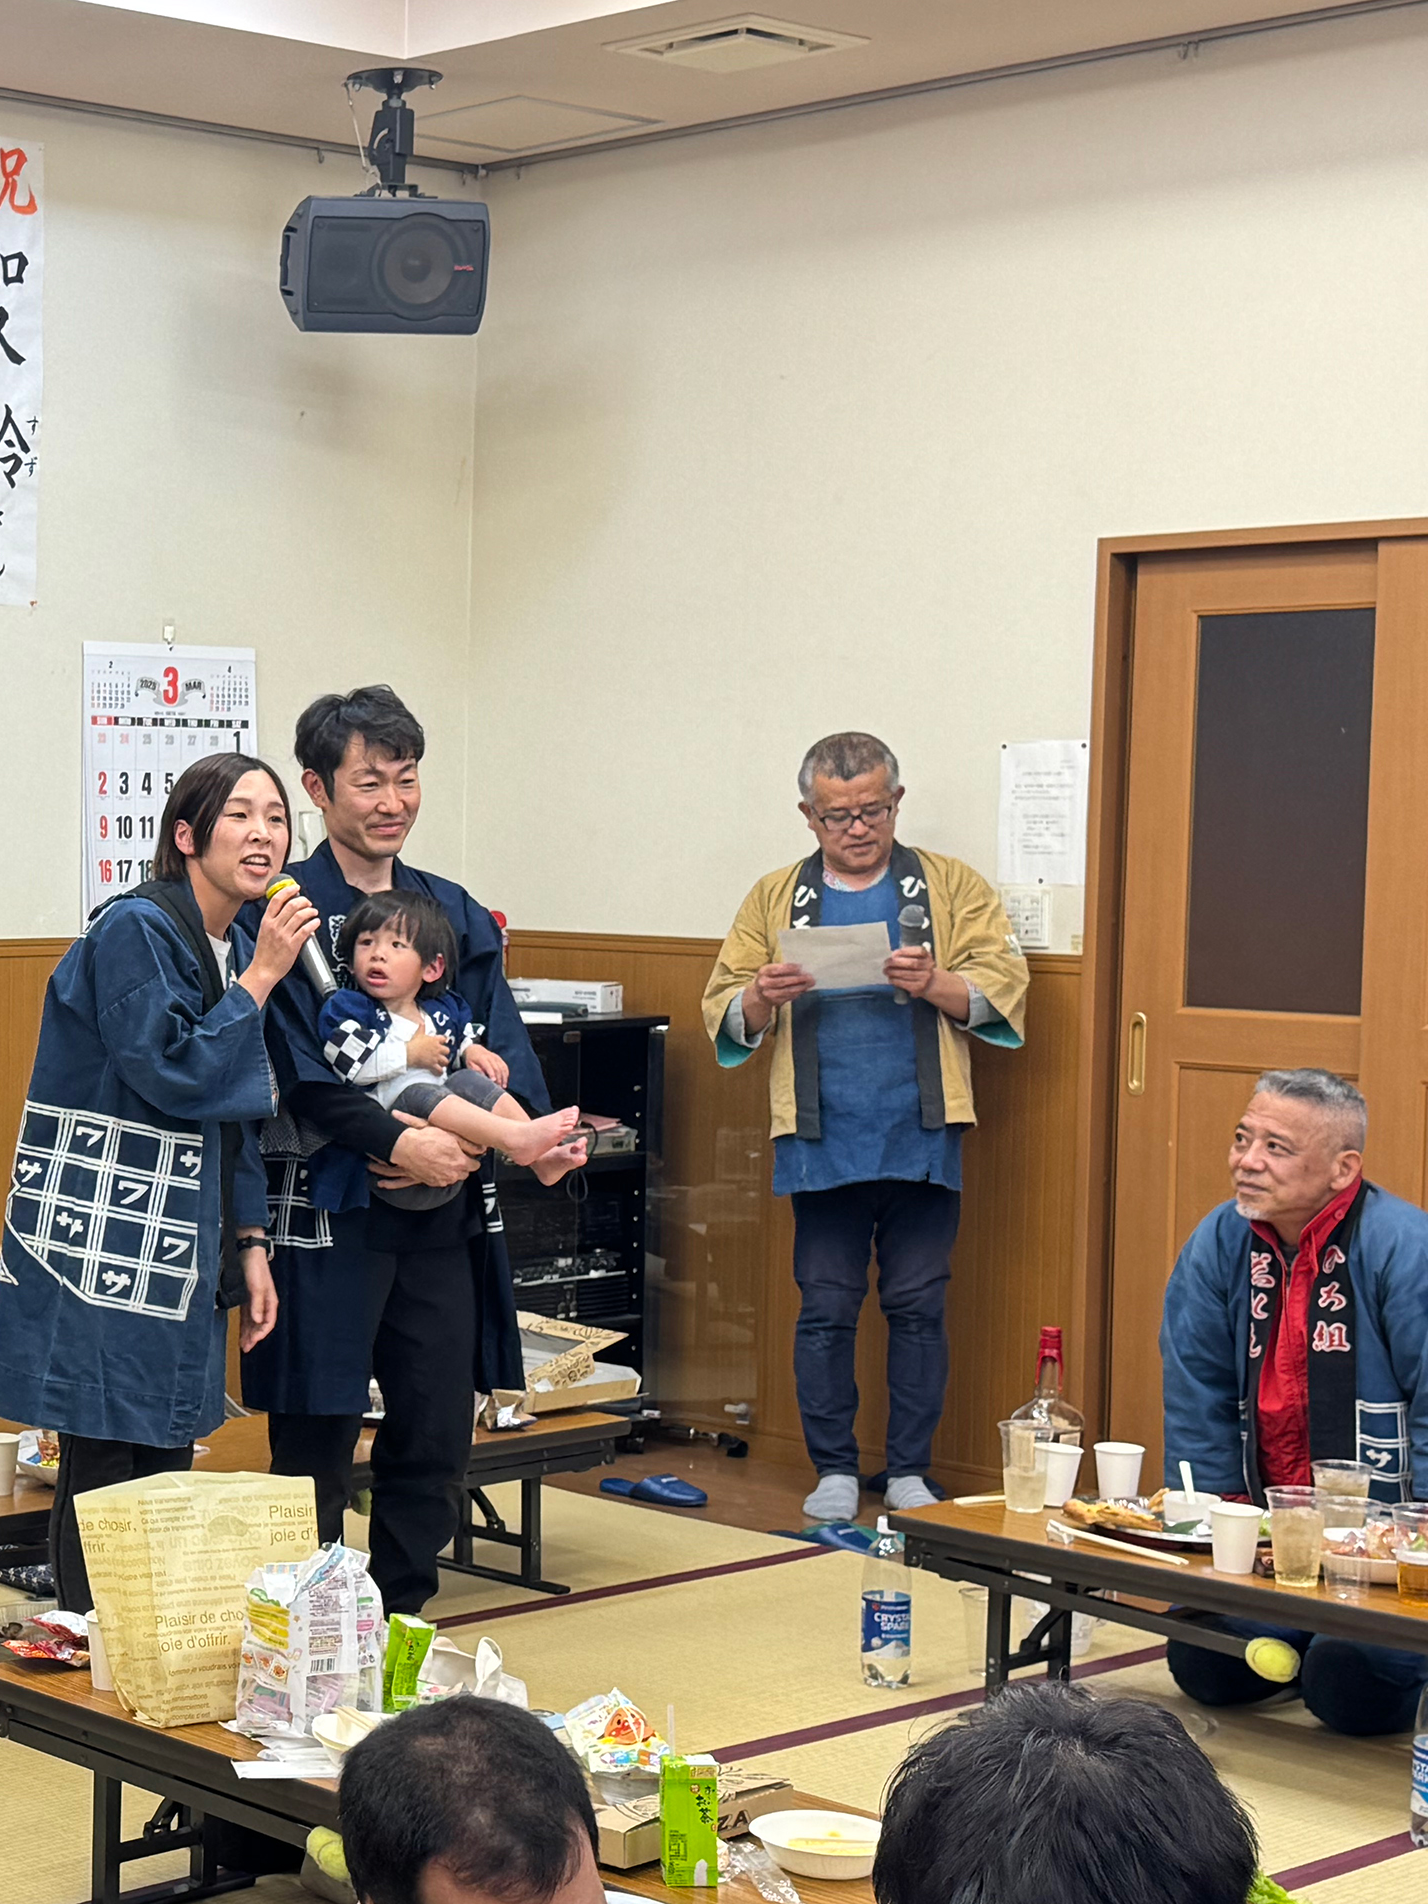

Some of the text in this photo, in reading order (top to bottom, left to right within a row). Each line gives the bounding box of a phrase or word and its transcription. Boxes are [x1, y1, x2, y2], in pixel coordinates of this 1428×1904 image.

[163, 666, 179, 705] 3
[233, 731, 241, 753] 1
[98, 771, 174, 795] 2 3 4 5
[99, 815, 154, 839] 9 10 11
[98, 859, 112, 883] 16
[116, 860, 133, 883] 17
[75, 1125, 103, 1147] ワ
[18, 1159, 42, 1182] サ
[118, 1181, 149, 1205] ワ
[56, 1212, 83, 1238] サ
[163, 1236, 190, 1260] ワ
[102, 1270, 131, 1295] サ
[269, 1504, 314, 1519] Plaisir
[270, 1528, 296, 1546] joie
[155, 1612, 196, 1630] Plaisir
[200, 1611, 216, 1625] de
[158, 1634, 231, 1656] joie d'offrir.
